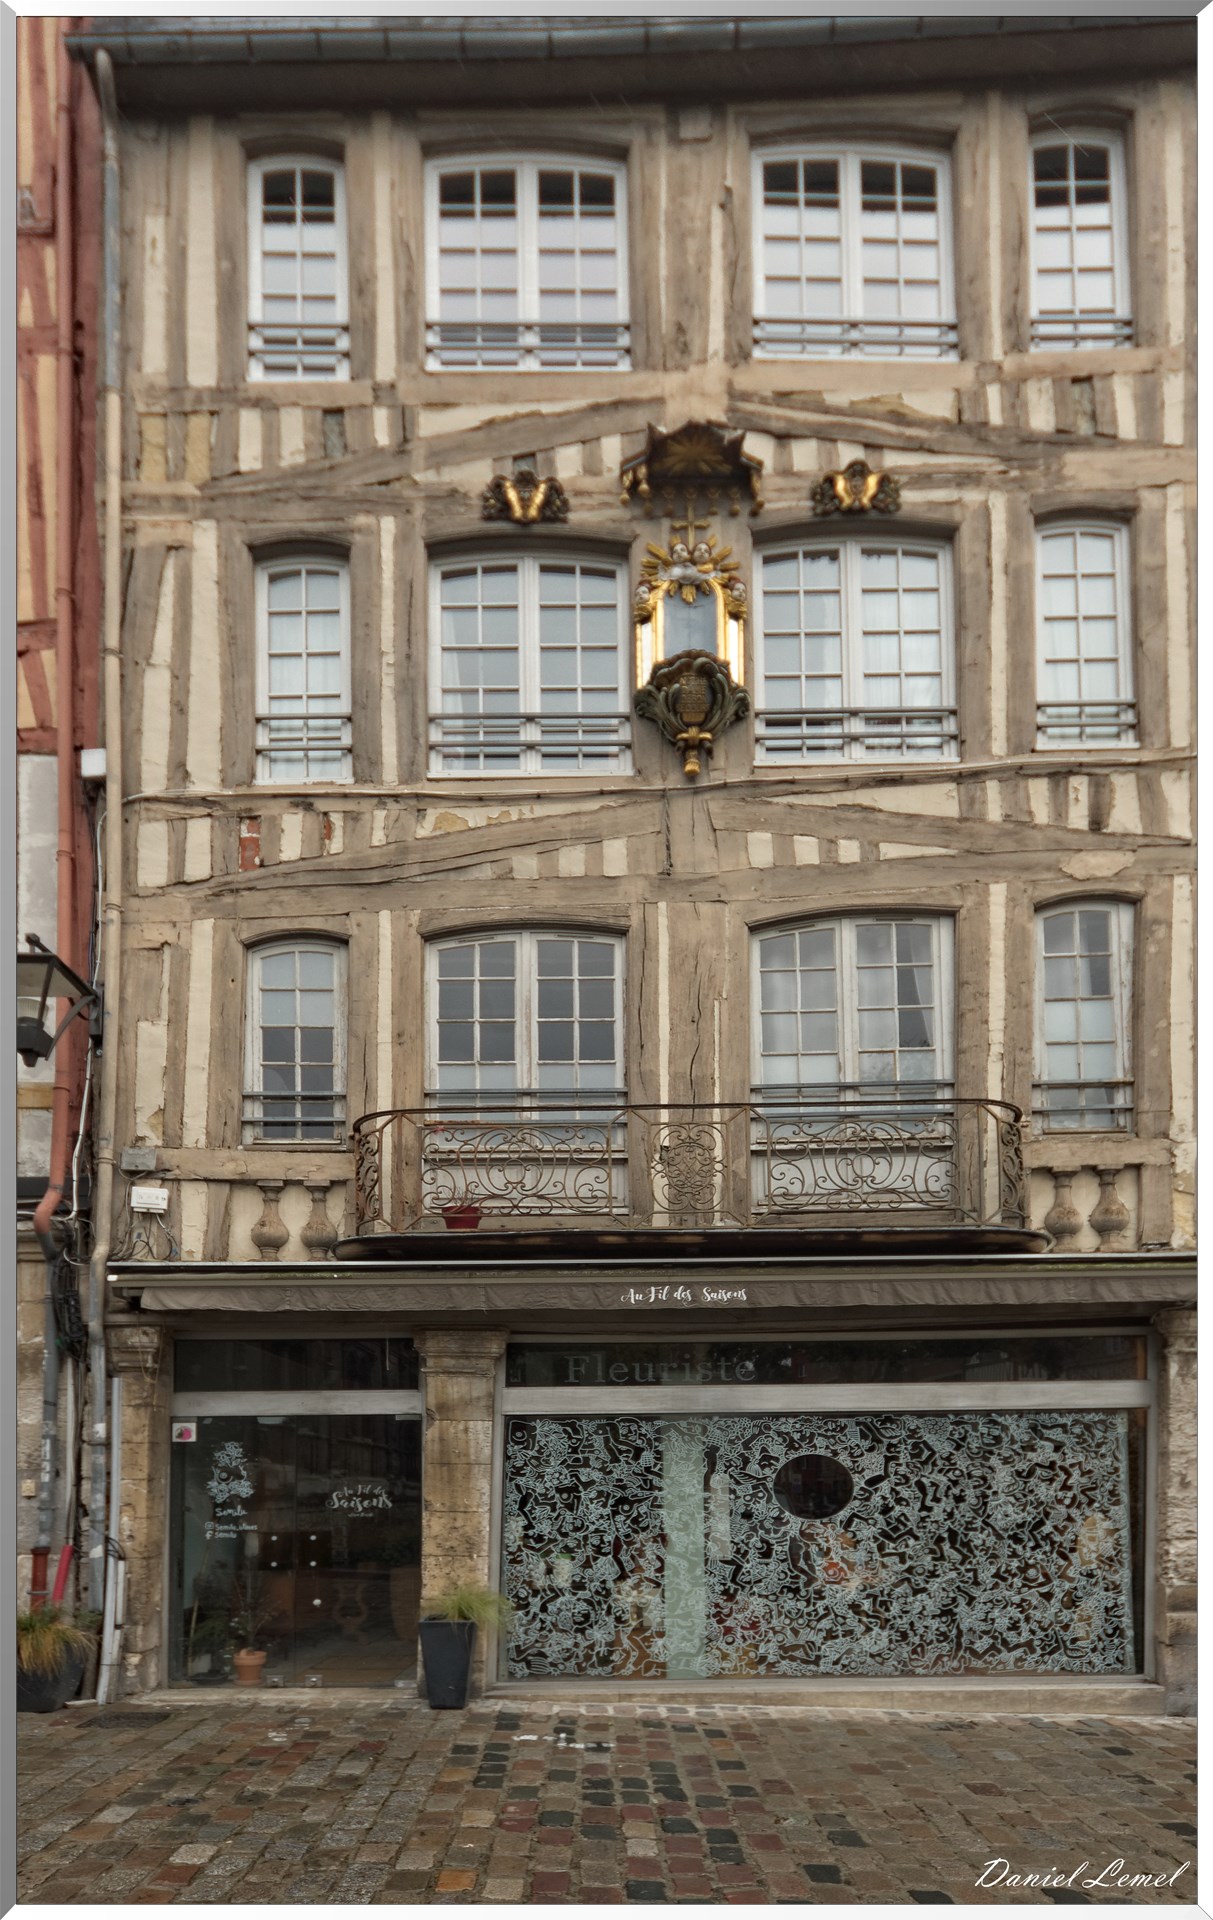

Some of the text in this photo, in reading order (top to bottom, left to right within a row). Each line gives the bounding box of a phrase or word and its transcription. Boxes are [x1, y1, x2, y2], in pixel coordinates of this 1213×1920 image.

[620, 1285, 747, 1305] Au Fil des Saisons
[563, 1352, 756, 1383] Fleuriste
[325, 1491, 393, 1512] Saisons
